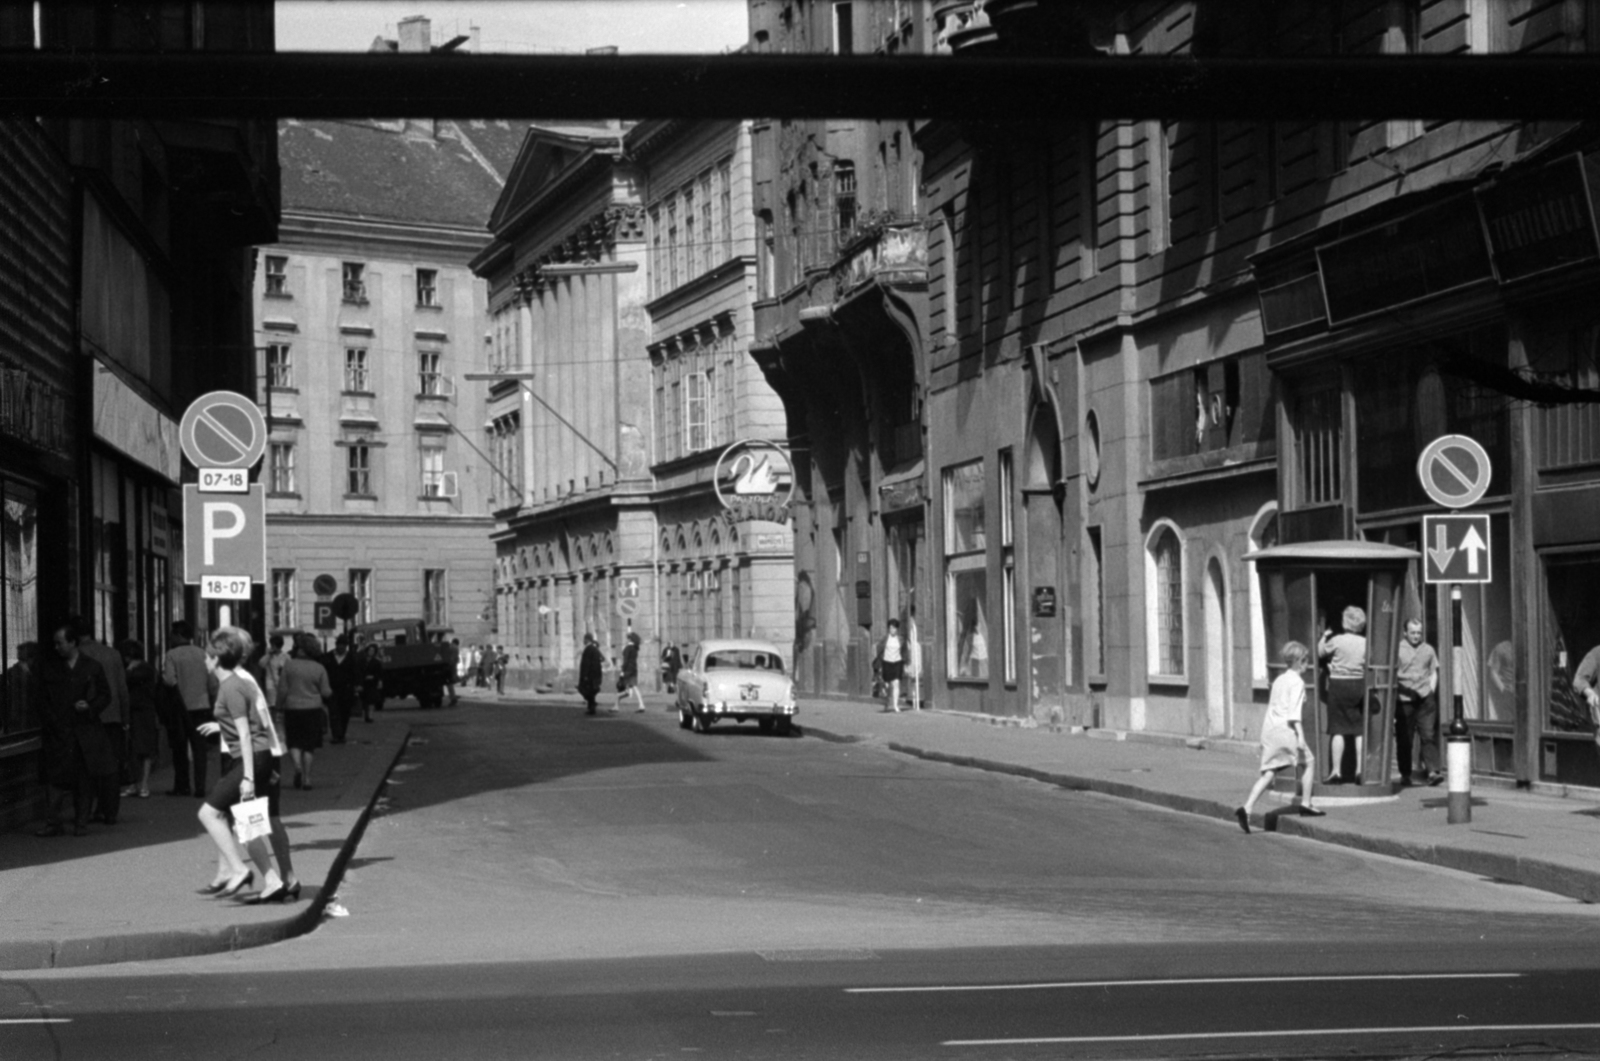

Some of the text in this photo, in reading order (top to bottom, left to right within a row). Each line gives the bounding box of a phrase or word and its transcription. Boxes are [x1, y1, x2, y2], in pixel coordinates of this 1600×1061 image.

[203, 473, 243, 487] 07-18
[203, 502, 246, 566] P
[207, 580, 246, 594] 18-07
[319, 606, 331, 625] P
